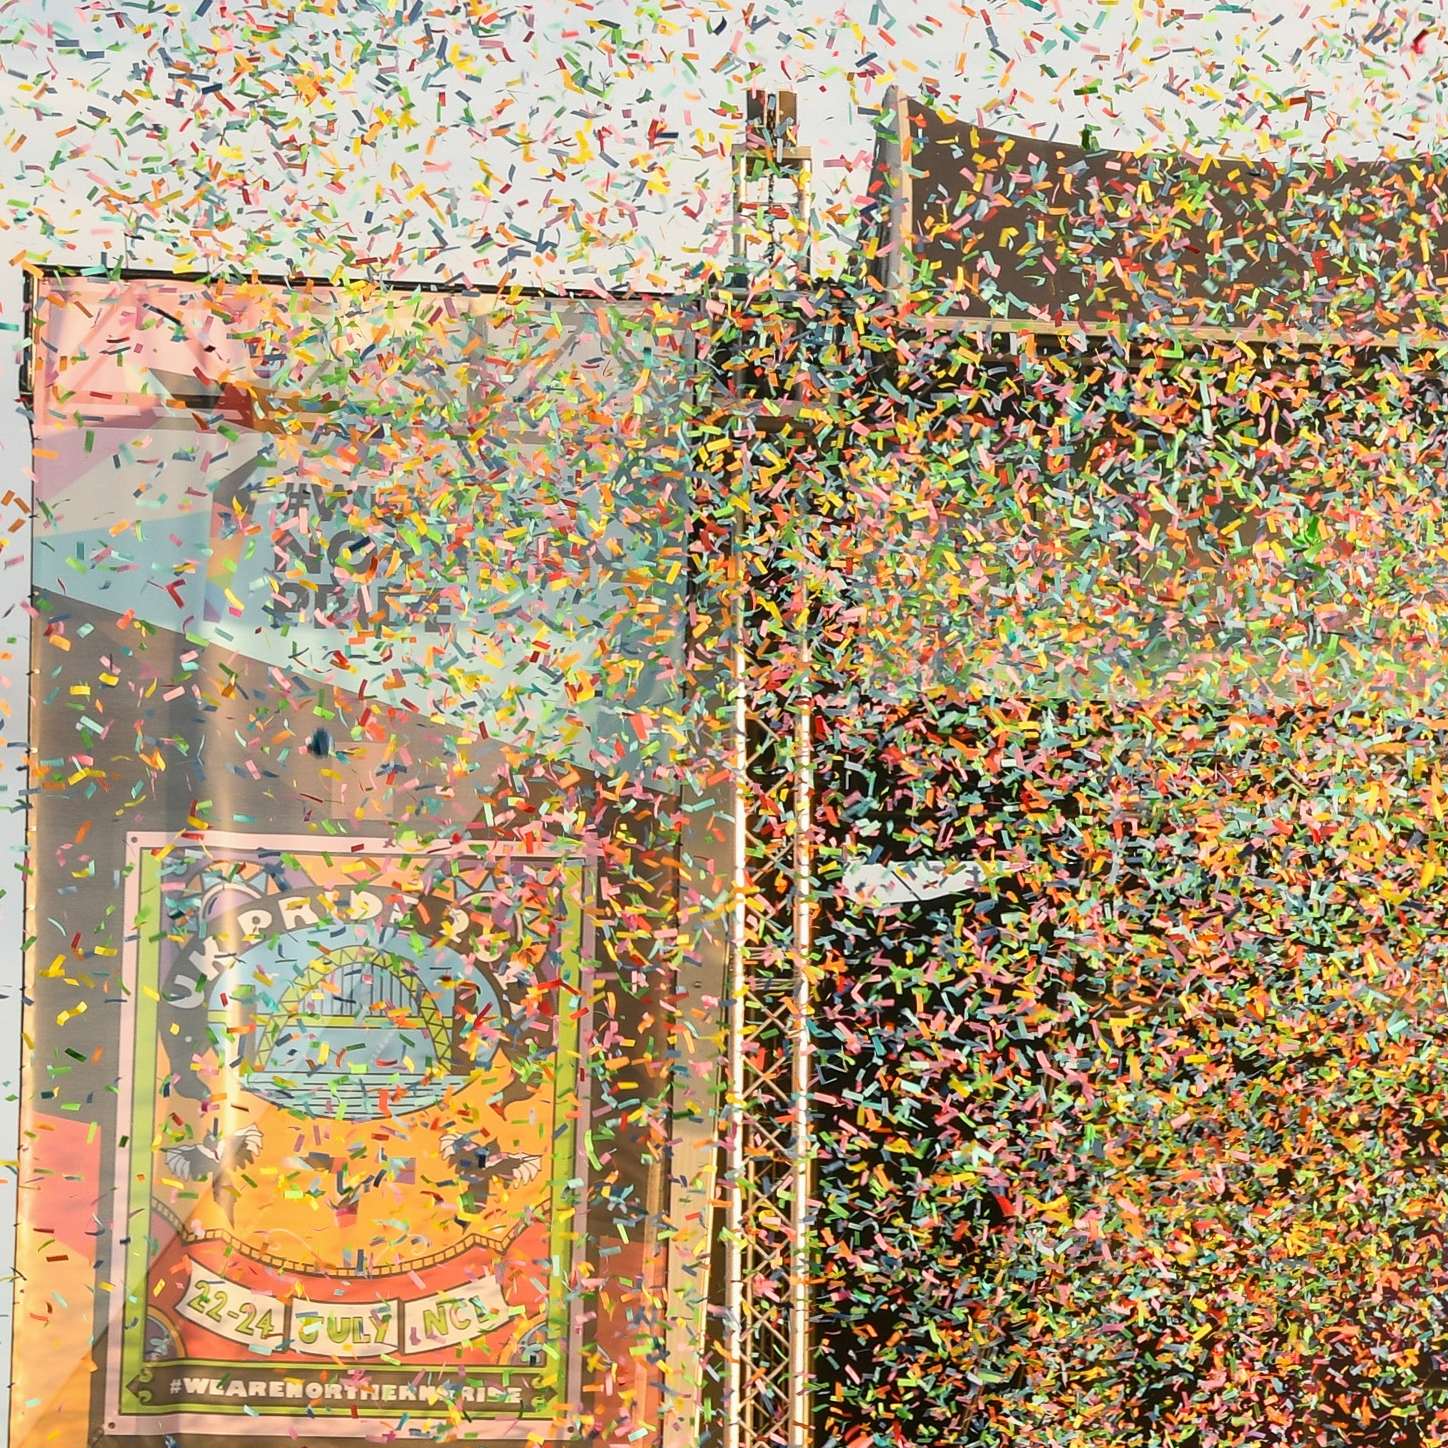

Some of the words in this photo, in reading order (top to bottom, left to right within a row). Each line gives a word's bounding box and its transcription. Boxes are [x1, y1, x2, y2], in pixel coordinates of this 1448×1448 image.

[167, 936, 240, 1010] UK
[187, 1280, 274, 1339] 22-24
[298, 1309, 392, 1344] JULY
[170, 1377, 523, 1404] #WEARENORTHERNRIDE
